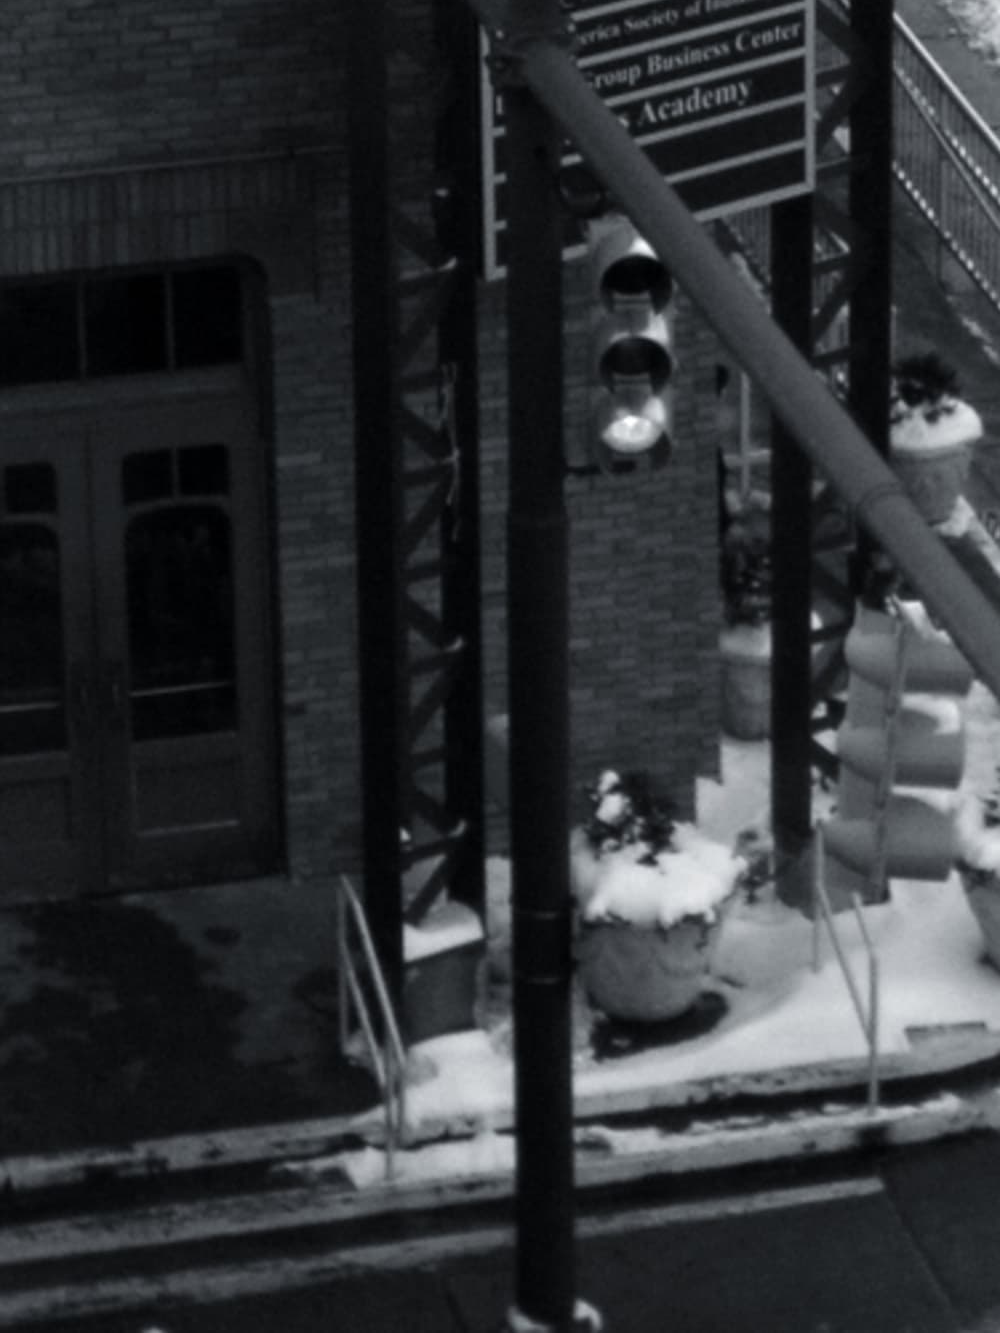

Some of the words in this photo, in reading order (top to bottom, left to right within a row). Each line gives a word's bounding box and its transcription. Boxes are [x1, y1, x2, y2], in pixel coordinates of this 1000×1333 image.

[577, 23, 621, 46] erica
[623, 9, 679, 35] Society
[592, 63, 643, 90] roup
[647, 42, 730, 77] Business
[735, 20, 802, 52] Center
[638, 78, 752, 126] Academy
